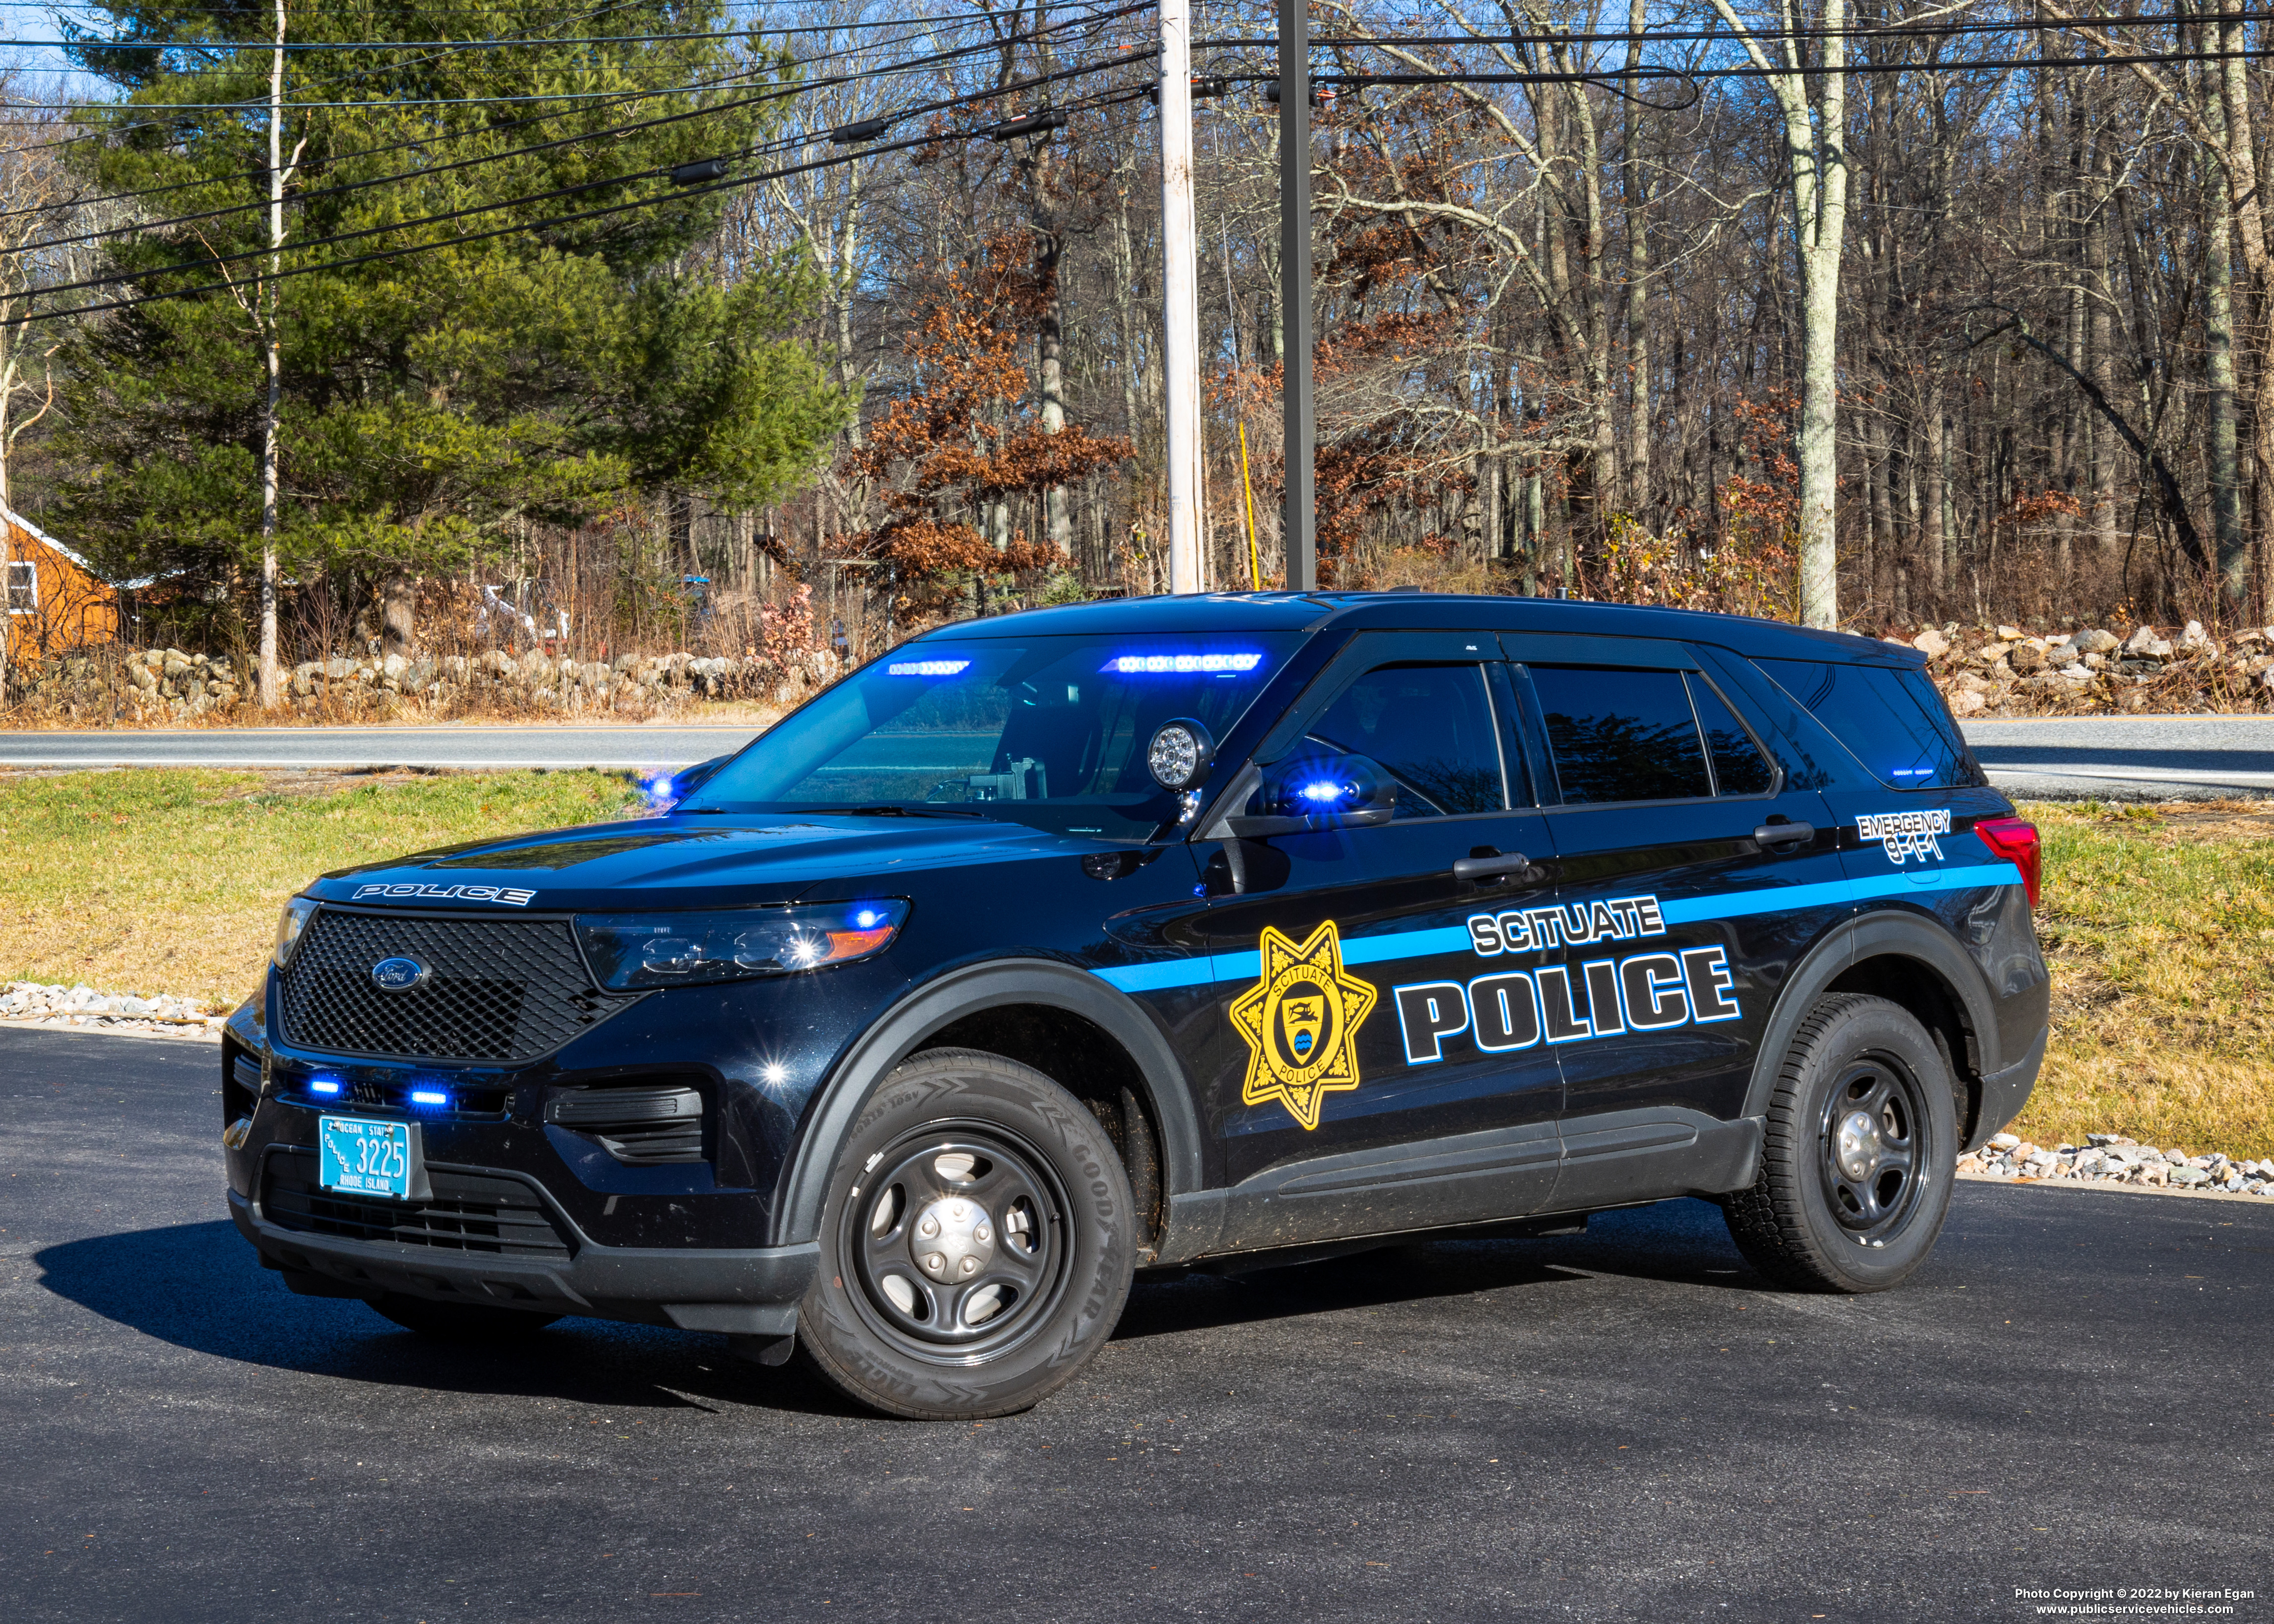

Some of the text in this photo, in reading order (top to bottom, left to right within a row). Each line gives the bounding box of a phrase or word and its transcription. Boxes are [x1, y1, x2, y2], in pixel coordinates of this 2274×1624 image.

[1855, 808, 1951, 841] EMERGENCY
[1883, 831, 1945, 864] 9-1-1
[351, 884, 538, 906] POLICE
[1467, 894, 1666, 957] SCITUATE
[379, 964, 408, 983] Ford
[1273, 968, 1332, 996] SCITUATE
[1393, 944, 1742, 1066] POLICE
[1279, 1058, 1325, 1083] POLICE
[339, 1123, 362, 1134] OCEAN
[325, 1133, 349, 1172] POLICE
[356, 1138, 404, 1178] 3225
[339, 1174, 389, 1190] RHODE ISLAND
